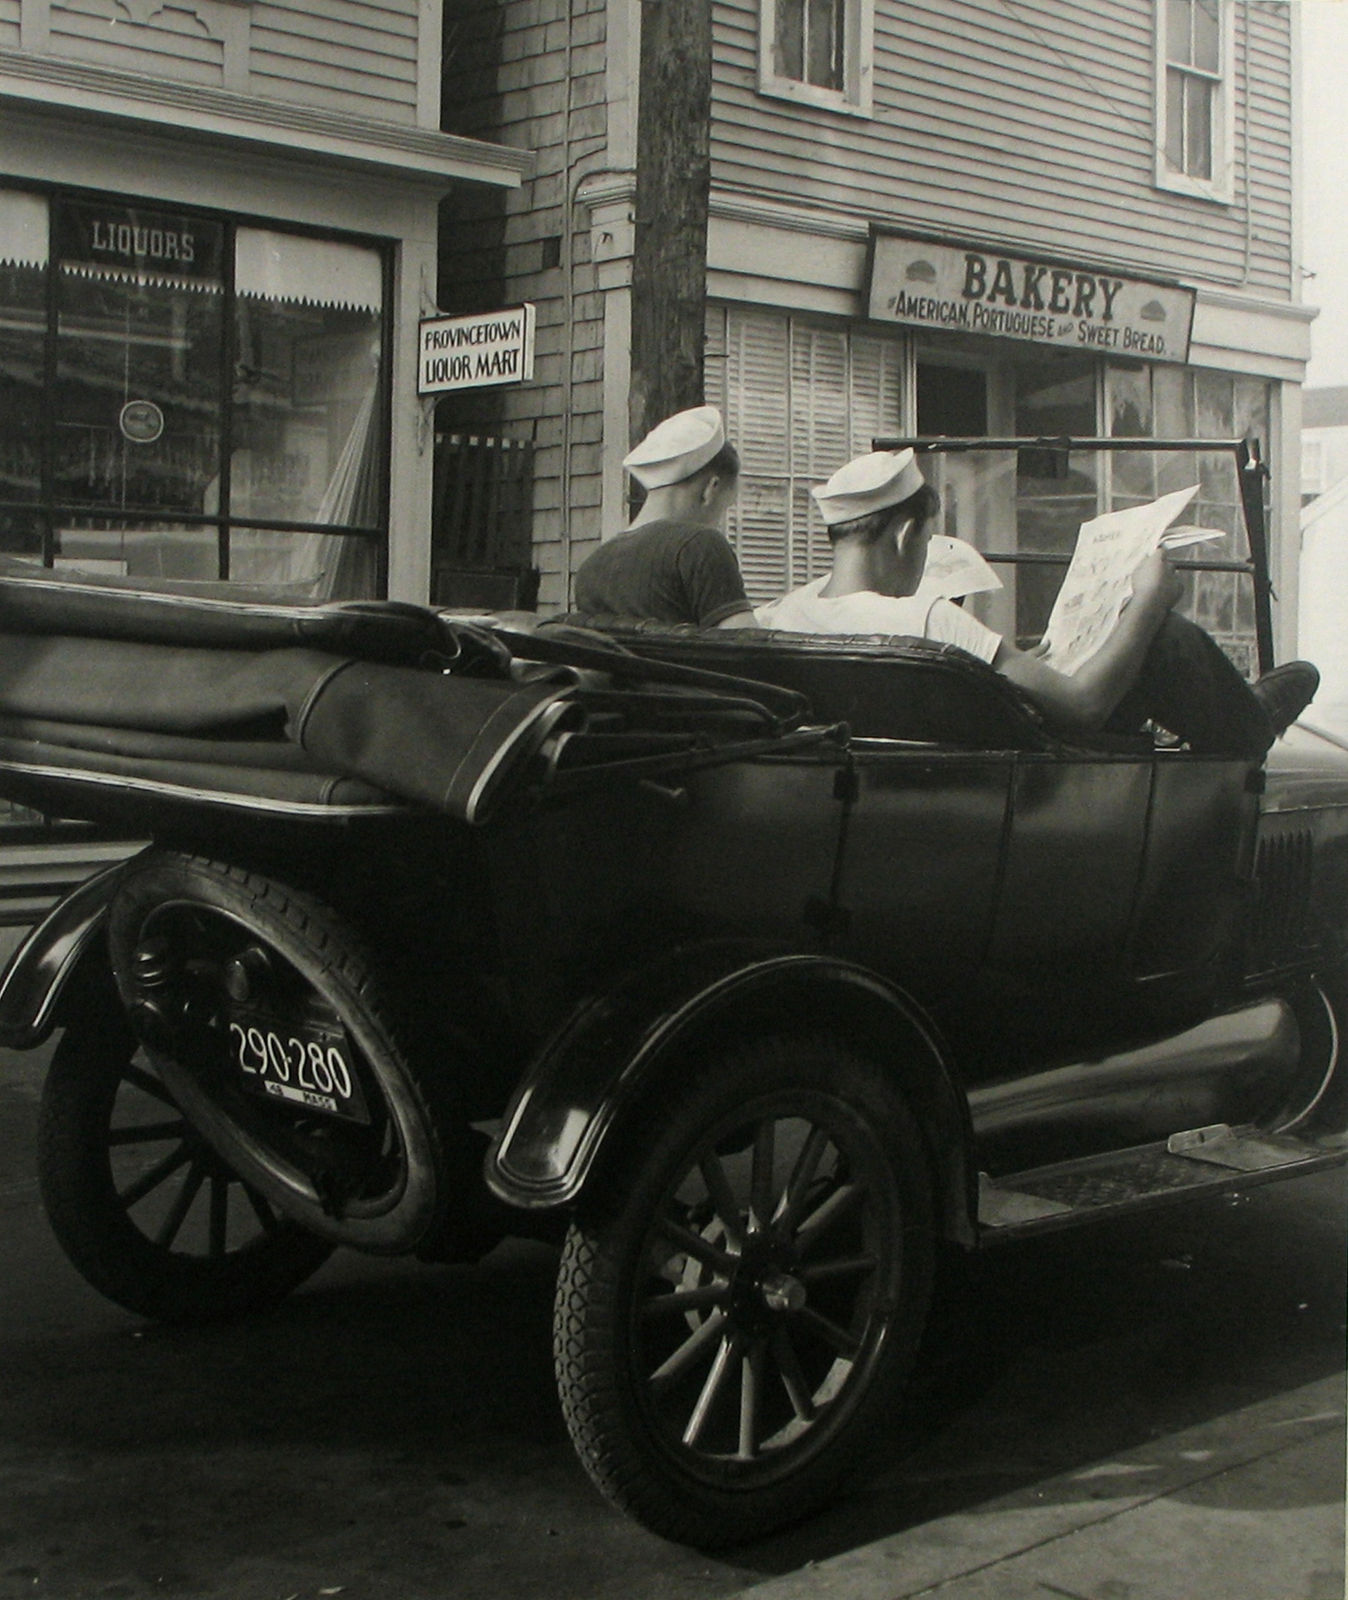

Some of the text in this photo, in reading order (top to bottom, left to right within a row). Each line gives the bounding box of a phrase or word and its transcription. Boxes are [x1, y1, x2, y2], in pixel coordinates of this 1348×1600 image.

[92, 221, 194, 262] LIQUORS
[961, 253, 1123, 321] BAKERY
[425, 319, 521, 350] PROVINCETOWN
[896, 290, 970, 328] AMERICAN,
[974, 302, 1054, 338] PORTUGUESE
[1078, 320, 1119, 347] SWEET
[426, 348, 520, 384] LIQUOR MART
